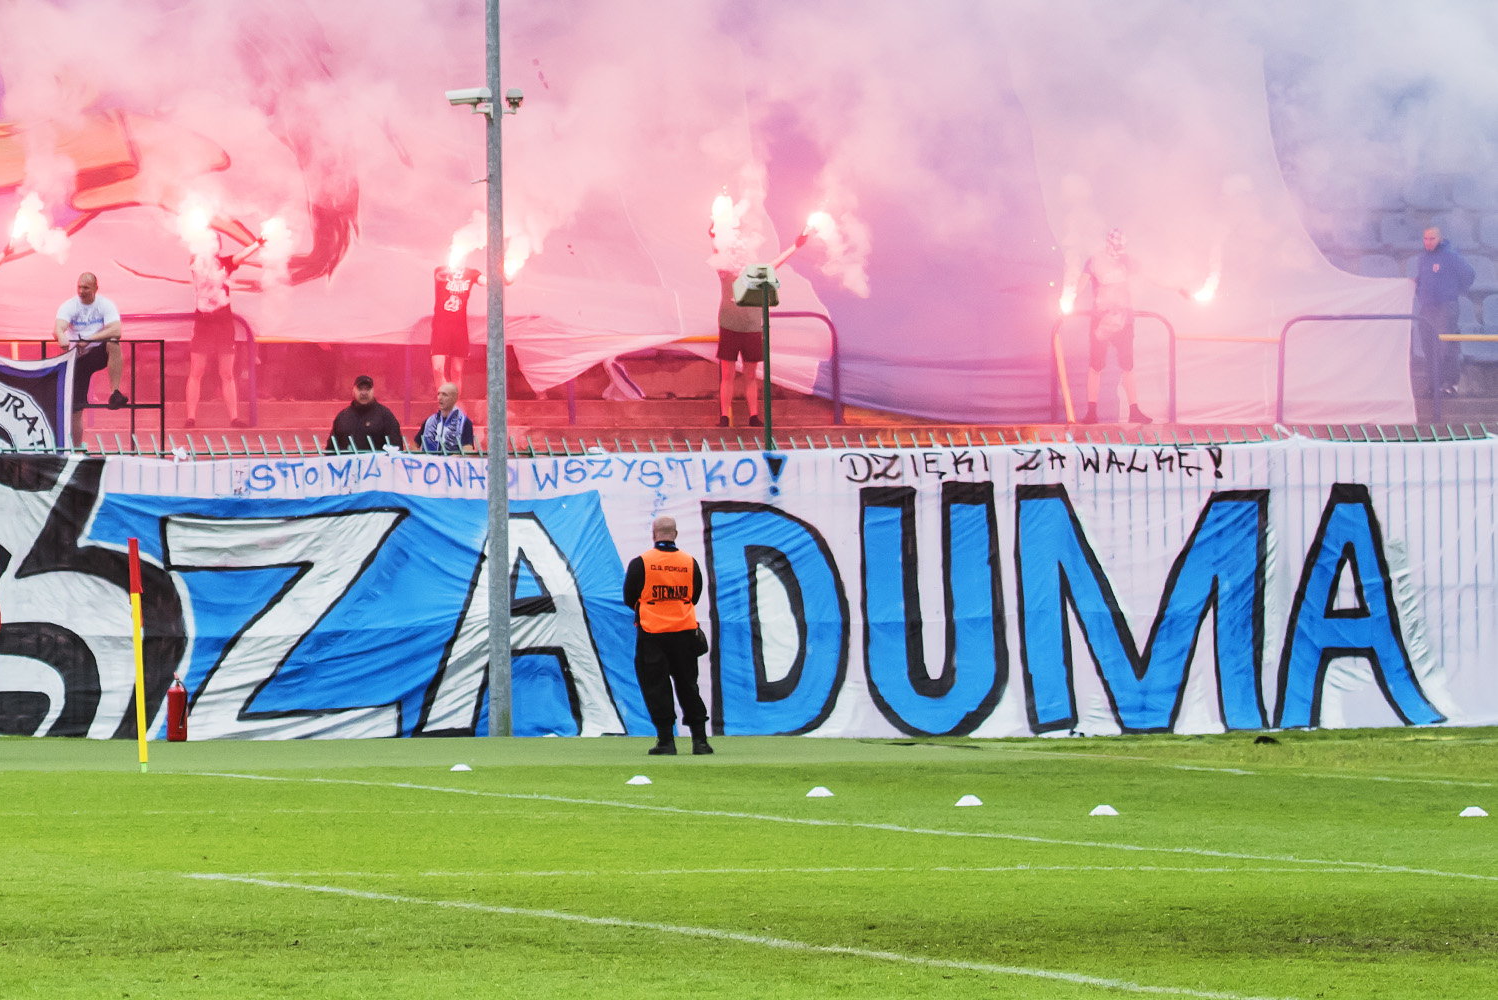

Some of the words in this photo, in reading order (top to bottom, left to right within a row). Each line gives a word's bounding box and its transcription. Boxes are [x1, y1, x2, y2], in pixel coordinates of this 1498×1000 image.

[244, 454, 382, 492] STOMIL
[1015, 448, 1067, 472] ZA
[652, 585, 689, 599] STEWARD
[702, 481, 1448, 738] DUMA
